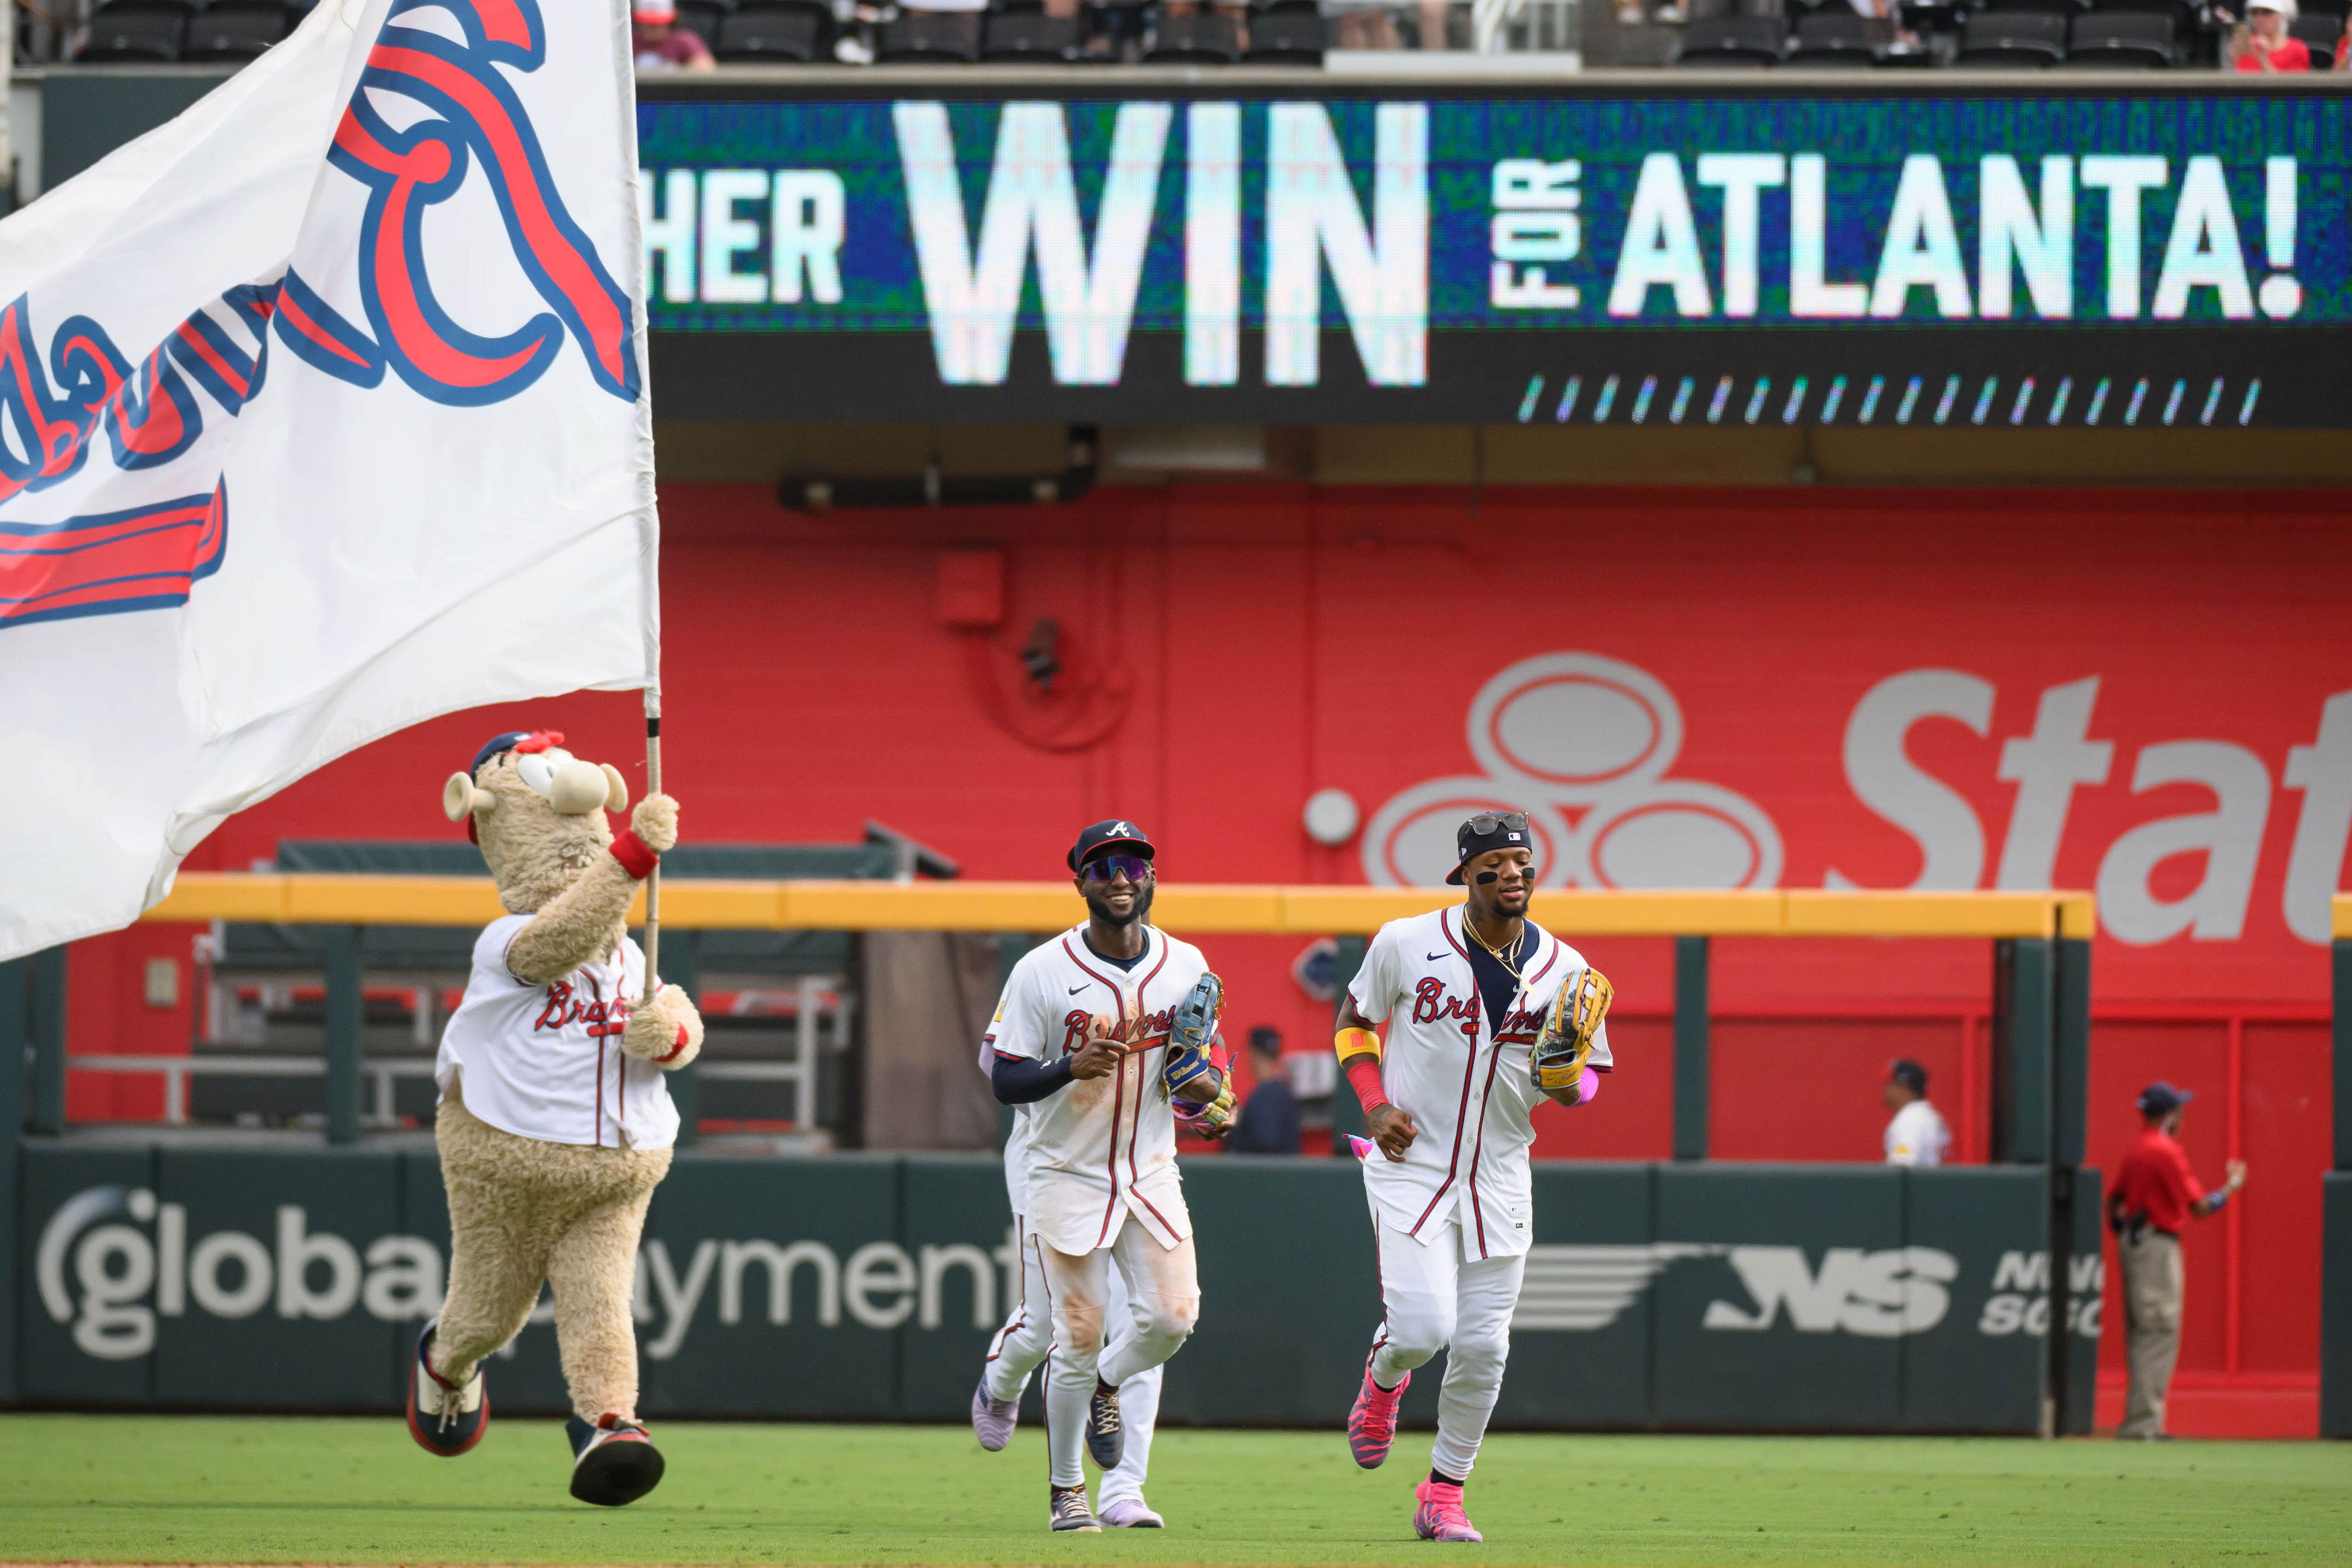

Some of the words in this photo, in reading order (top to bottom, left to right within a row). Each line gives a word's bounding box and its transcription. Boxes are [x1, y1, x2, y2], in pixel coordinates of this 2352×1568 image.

[892, 101, 1430, 386] WIN
[1490, 158, 1582, 310] FOR
[1607, 151, 2304, 320] ATLANTA!
[1106, 822, 1130, 837] A
[1170, 1060, 1199, 1081] Wilson
[73, 1202, 448, 1359] globa
